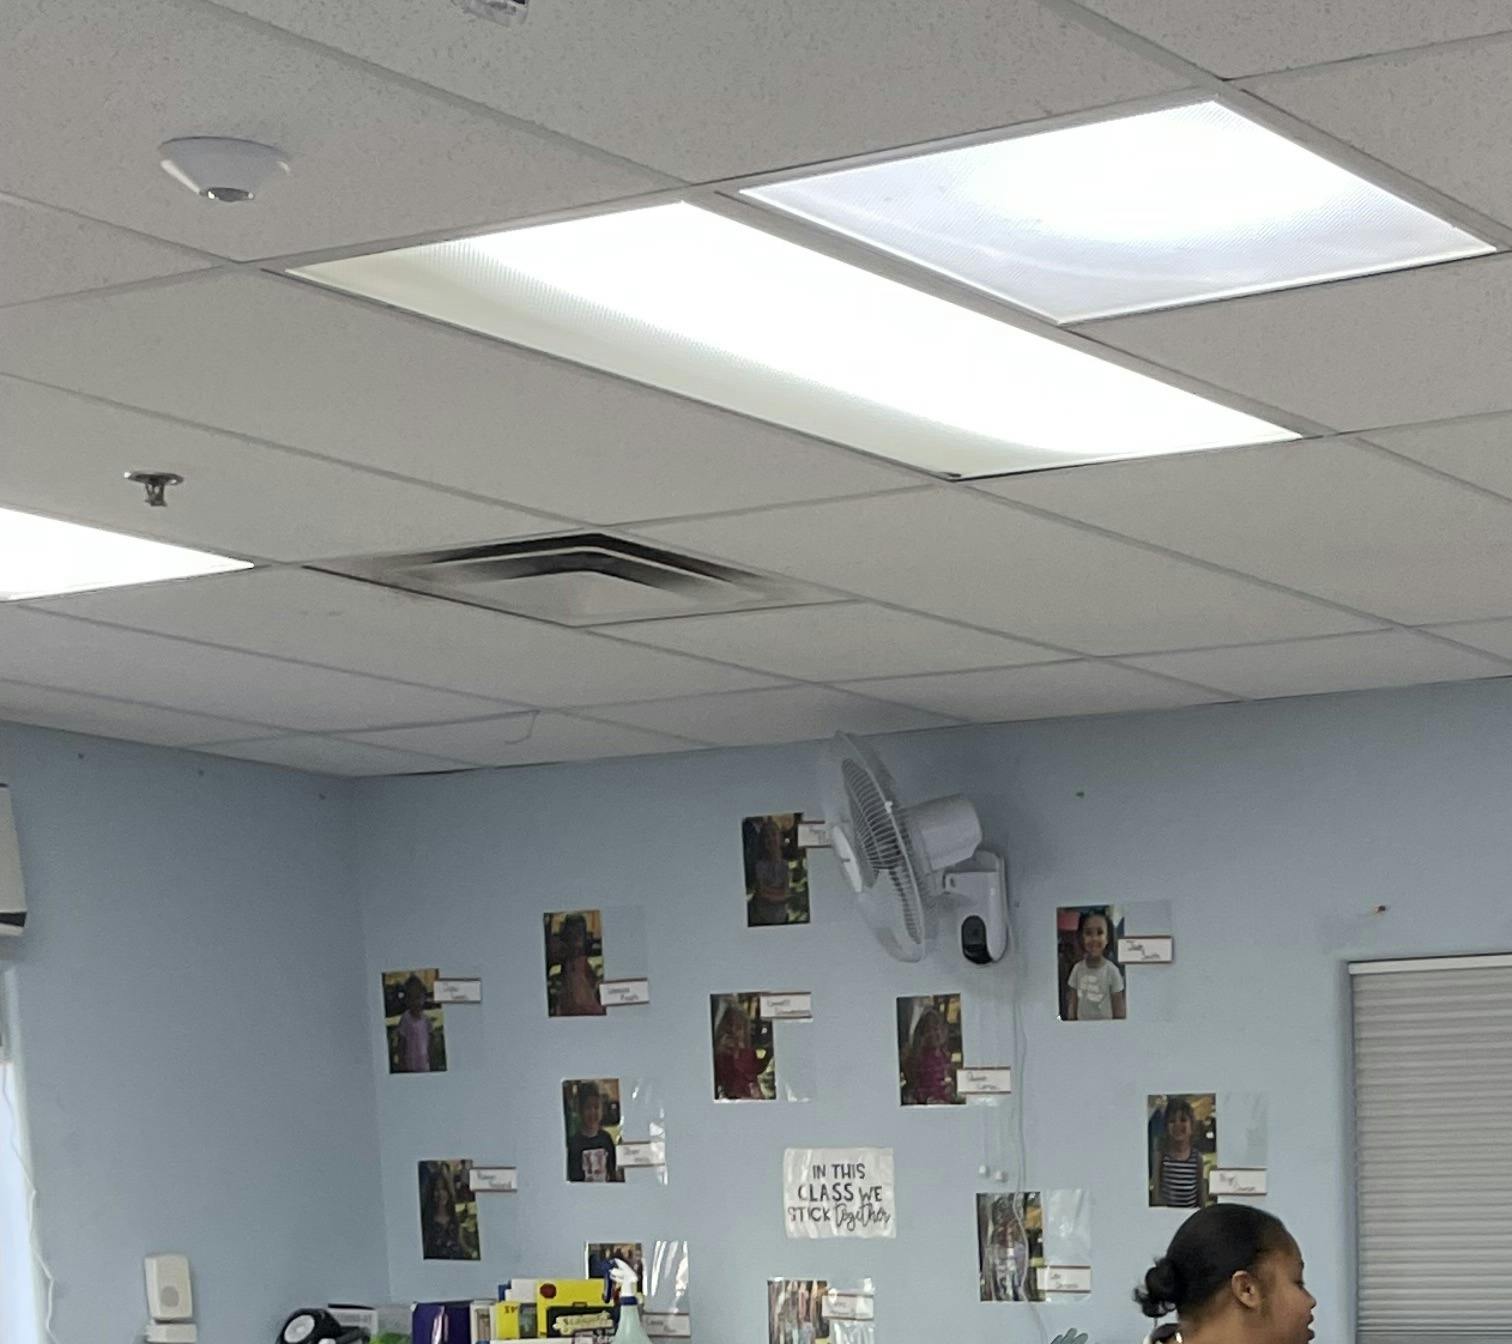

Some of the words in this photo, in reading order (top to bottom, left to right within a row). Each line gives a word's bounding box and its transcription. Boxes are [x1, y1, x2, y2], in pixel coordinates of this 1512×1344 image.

[812, 1164, 826, 1179] IN
[832, 1163, 866, 1179] THIS
[798, 1182, 854, 1202] CLASS
[859, 1186, 882, 1202] WE
[788, 1206, 830, 1222] STICK
